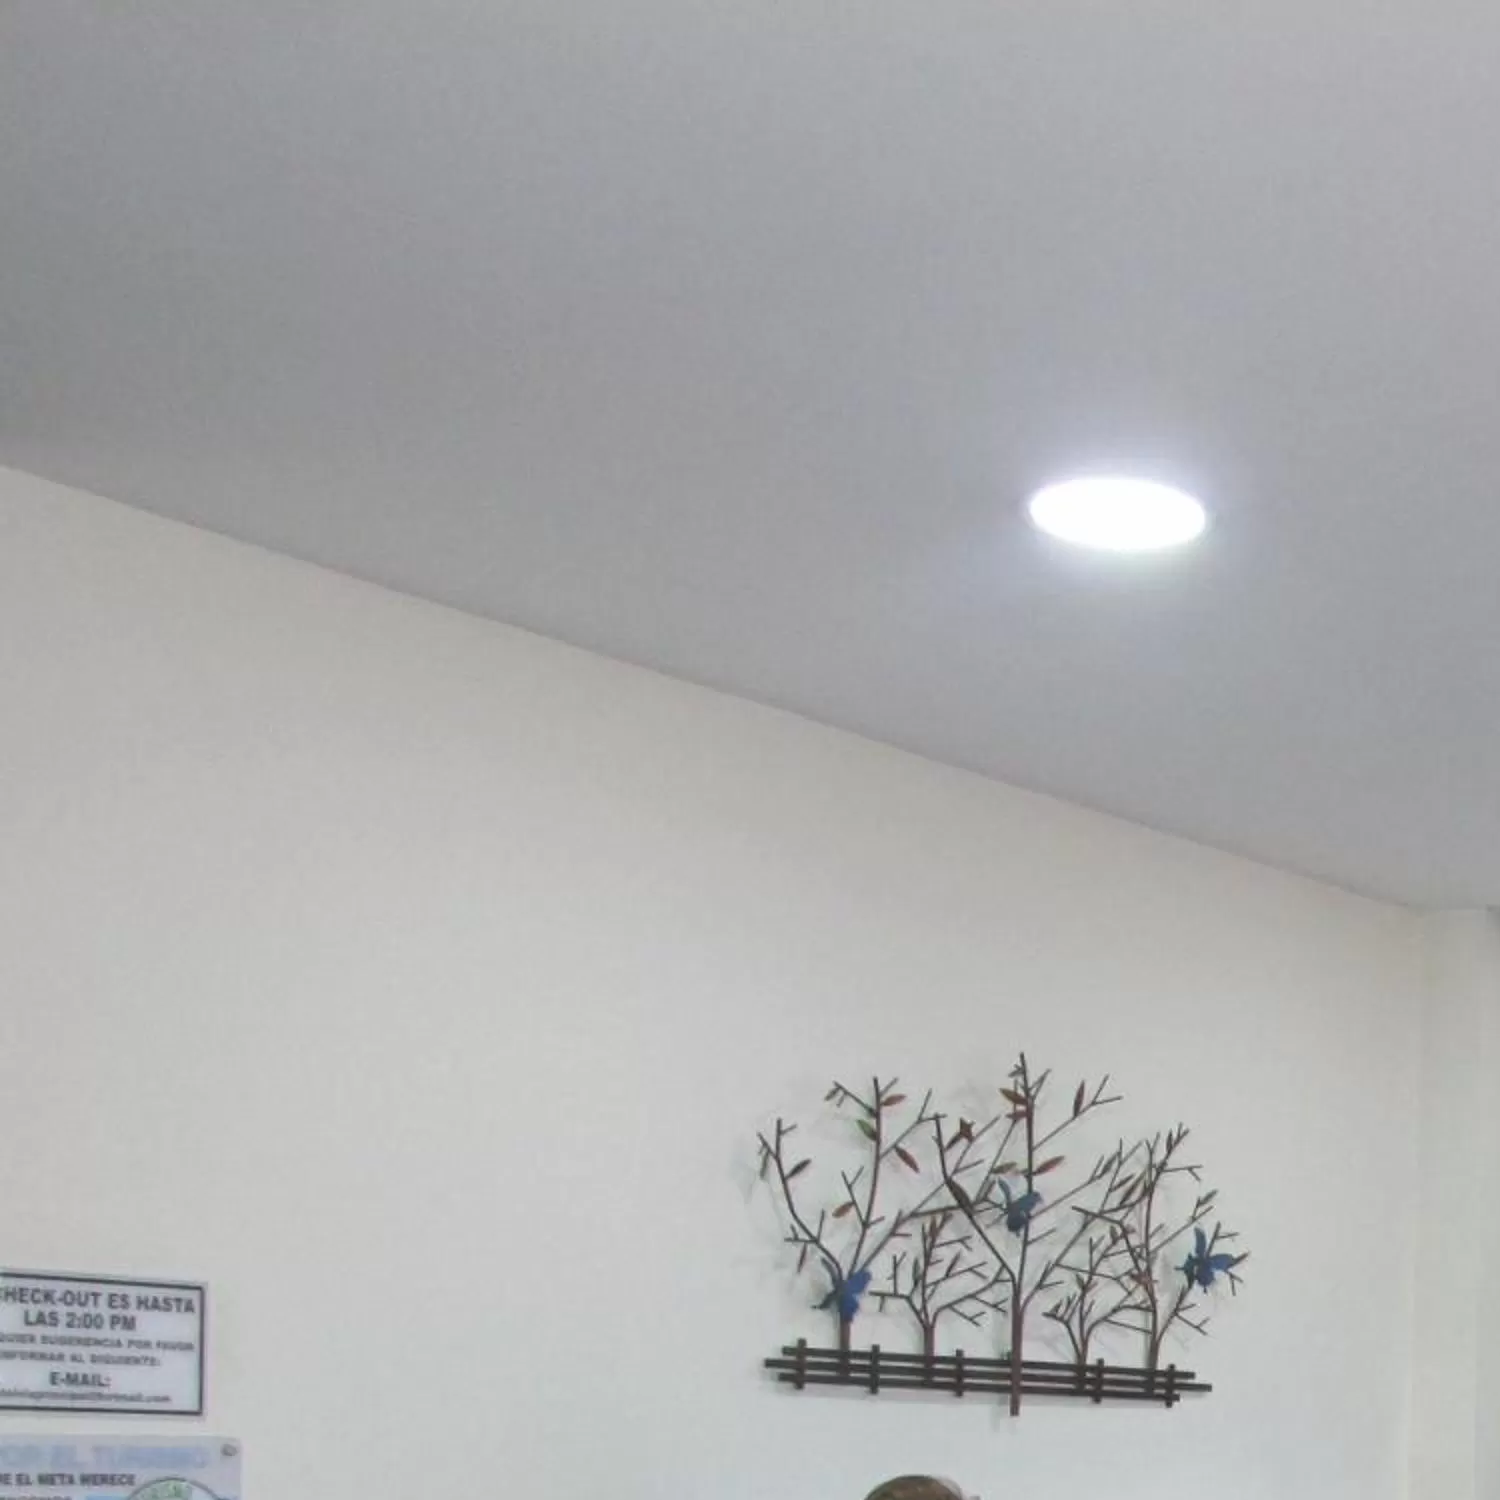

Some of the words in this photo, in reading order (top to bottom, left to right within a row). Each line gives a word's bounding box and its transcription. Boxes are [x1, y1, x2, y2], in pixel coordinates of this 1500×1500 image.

[107, 1293, 130, 1310] ES
[135, 1296, 196, 1314] HASTA
[23, 1310, 59, 1328] LAS
[65, 1313, 104, 1330] 2:00
[109, 1315, 137, 1332] PM
[49, 1371, 112, 1388] E-MAIL:
